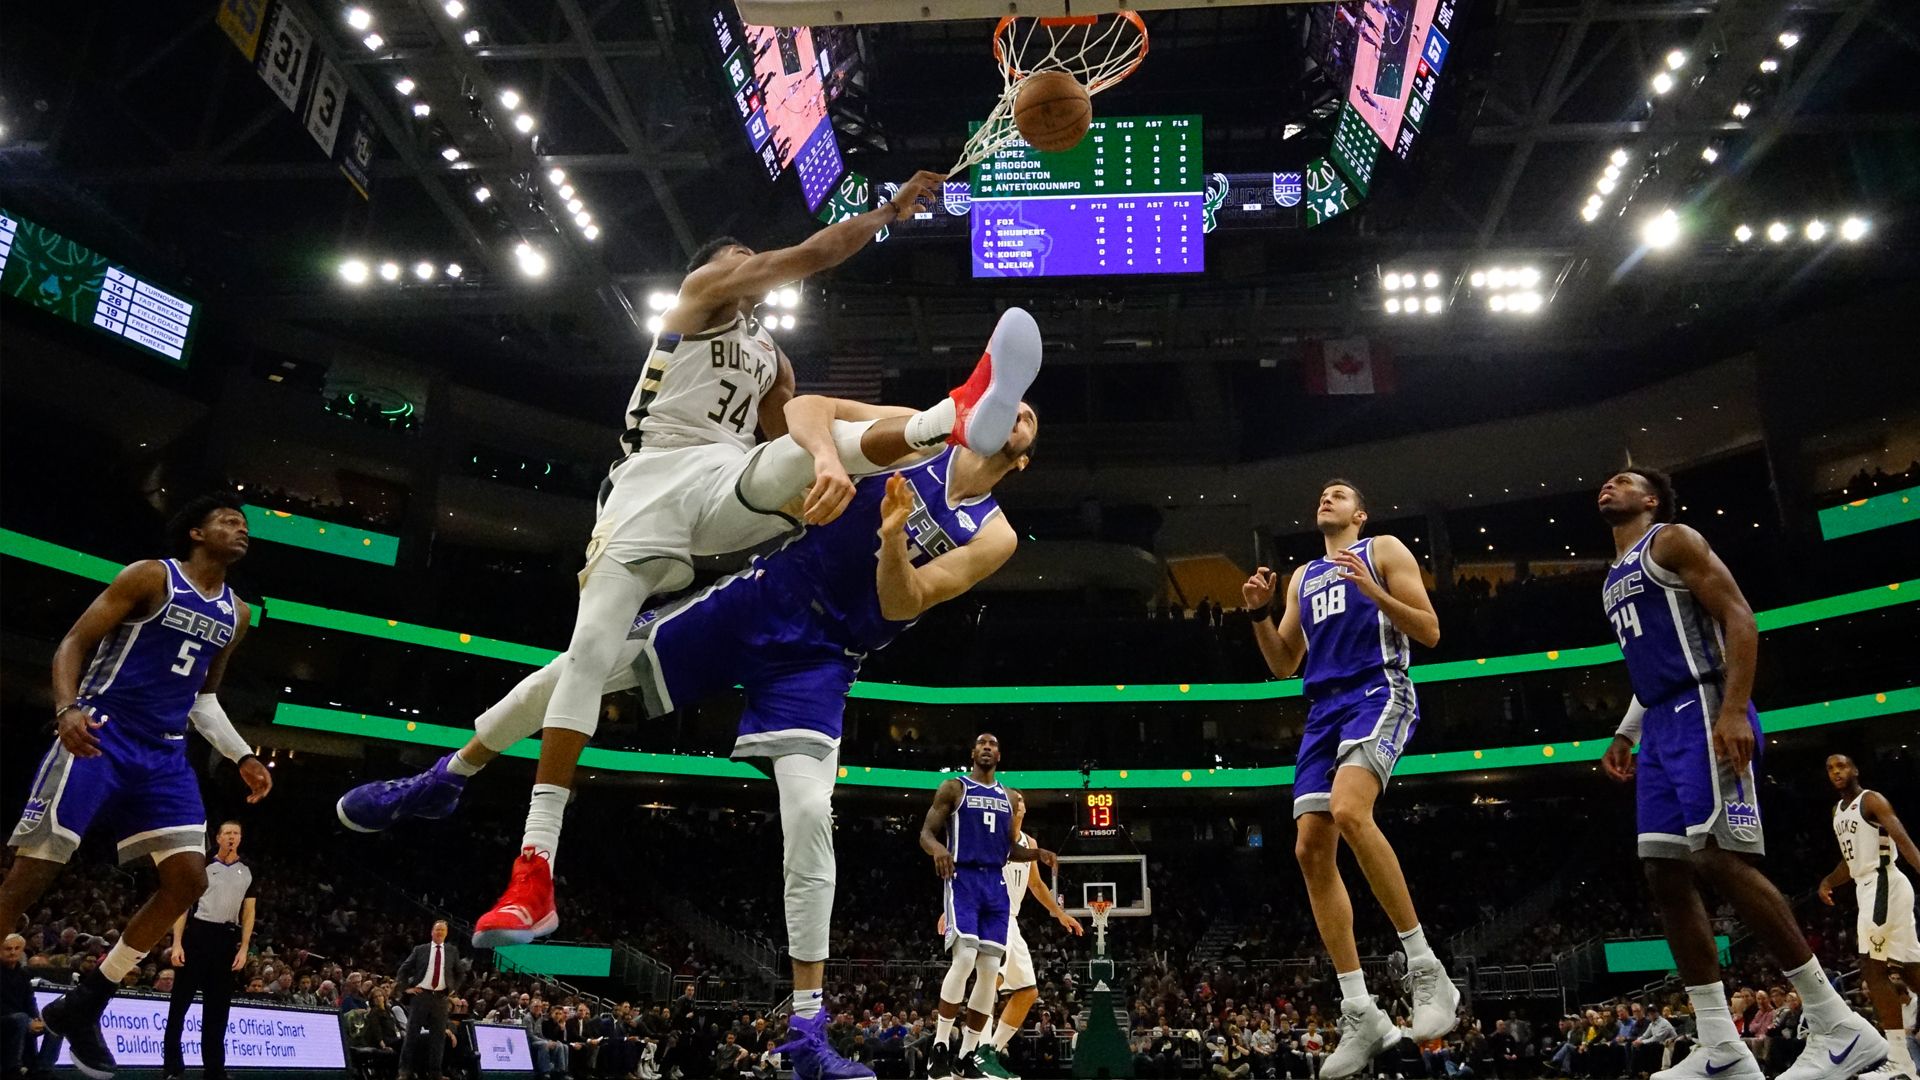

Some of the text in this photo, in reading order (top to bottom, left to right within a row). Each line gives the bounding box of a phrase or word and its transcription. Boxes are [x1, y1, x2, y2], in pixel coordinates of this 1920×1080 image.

[274, 32, 300, 86] 31
[1428, 36, 1442, 64] 57
[730, 58, 744, 87] 82
[319, 87, 336, 128] 3
[1410, 97, 1424, 122] 82
[752, 116, 766, 140] 57
[995, 161, 1040, 169] BROGDON
[995, 172, 1050, 180] MIDDLETON
[996, 182, 1080, 191] ANTETOKOUNMPO
[113, 284, 183, 320] 14 FAST BREAKS
[145, 287, 184, 309] TURNOVERS
[107, 295, 179, 331] 26 FIELD GOALS
[105, 319, 166, 350] 11 THREES
[107, 307, 178, 343] 19 FREE THROWS
[710, 340, 772, 396] BUCKS
[708, 378, 752, 434] 34
[1312, 584, 1346, 625] 88
[161, 603, 232, 648] SAC
[1610, 602, 1643, 649] 24
[171, 639, 202, 676] 5
[966, 795, 1009, 813] SAC
[1088, 794, 1112, 807] 8:03
[22, 811, 43, 821] AC
[983, 812, 996, 833] 9
[1092, 807, 1110, 826] 13
[1728, 816, 1757, 826] SAC
[1836, 819, 1858, 836] UCKS
[1842, 839, 1854, 861] 22
[1015, 869, 1021, 887] 11
[102, 1010, 149, 1030] ohnson
[239, 1018, 275, 1036] Official
[277, 1020, 305, 1038] Smart
[232, 1039, 262, 1056] Fiserv
[265, 1041, 296, 1058] Forum
